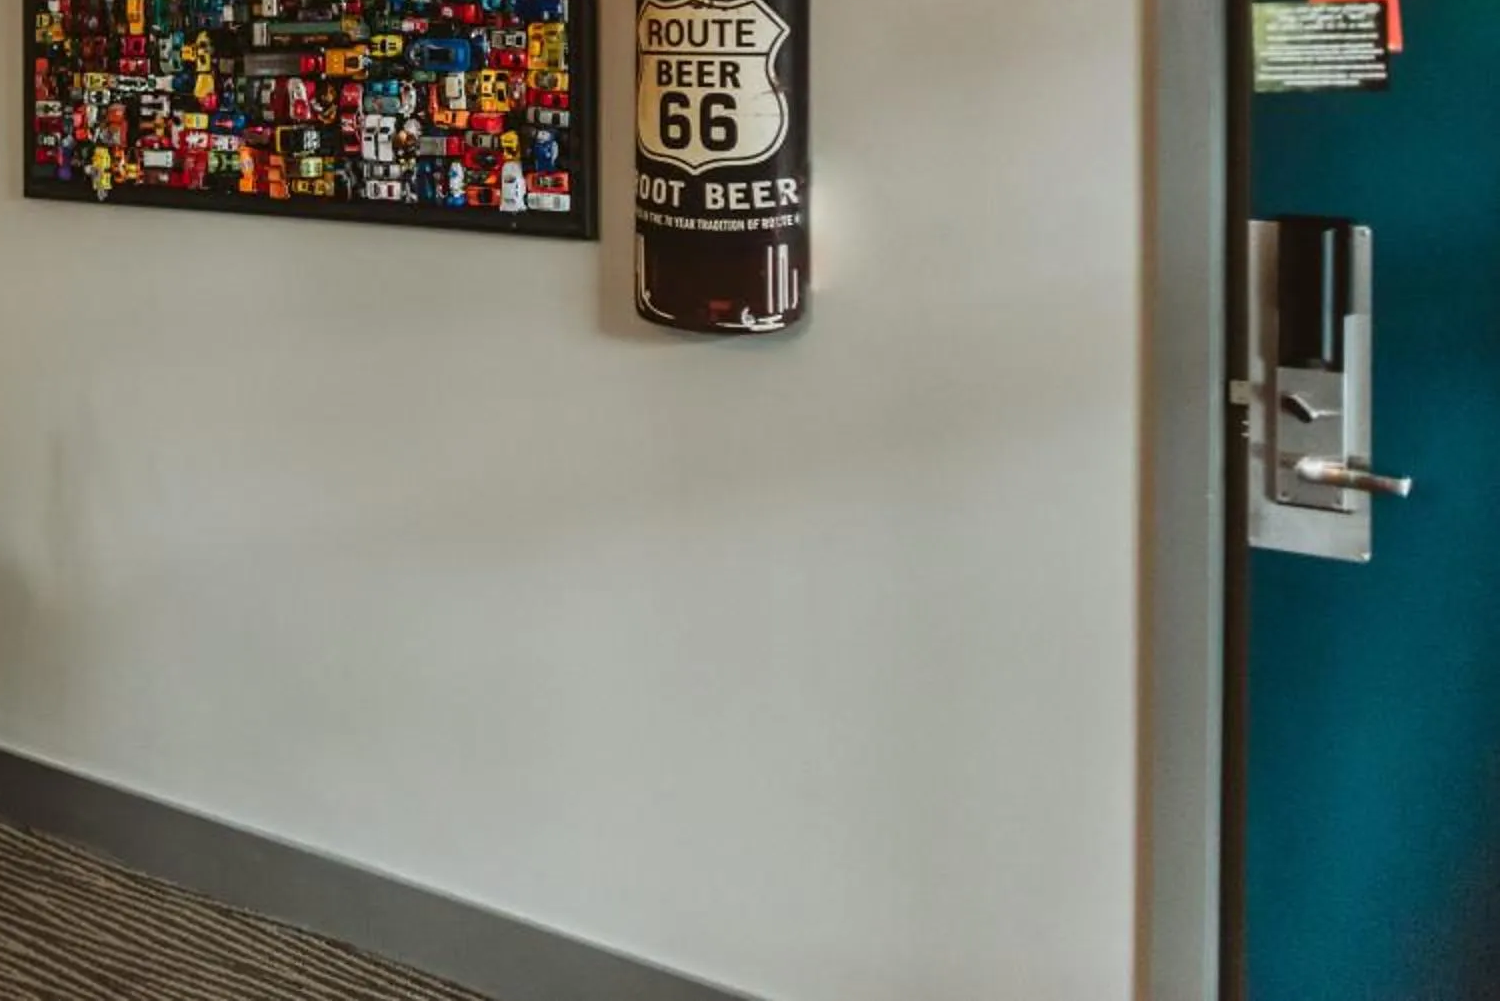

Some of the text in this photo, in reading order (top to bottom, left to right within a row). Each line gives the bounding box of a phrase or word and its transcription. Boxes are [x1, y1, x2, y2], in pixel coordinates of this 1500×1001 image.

[647, 18, 757, 48] ROUTE
[656, 59, 741, 88] BEER
[659, 91, 739, 151] 66
[636, 173, 800, 210] OOT BEER
